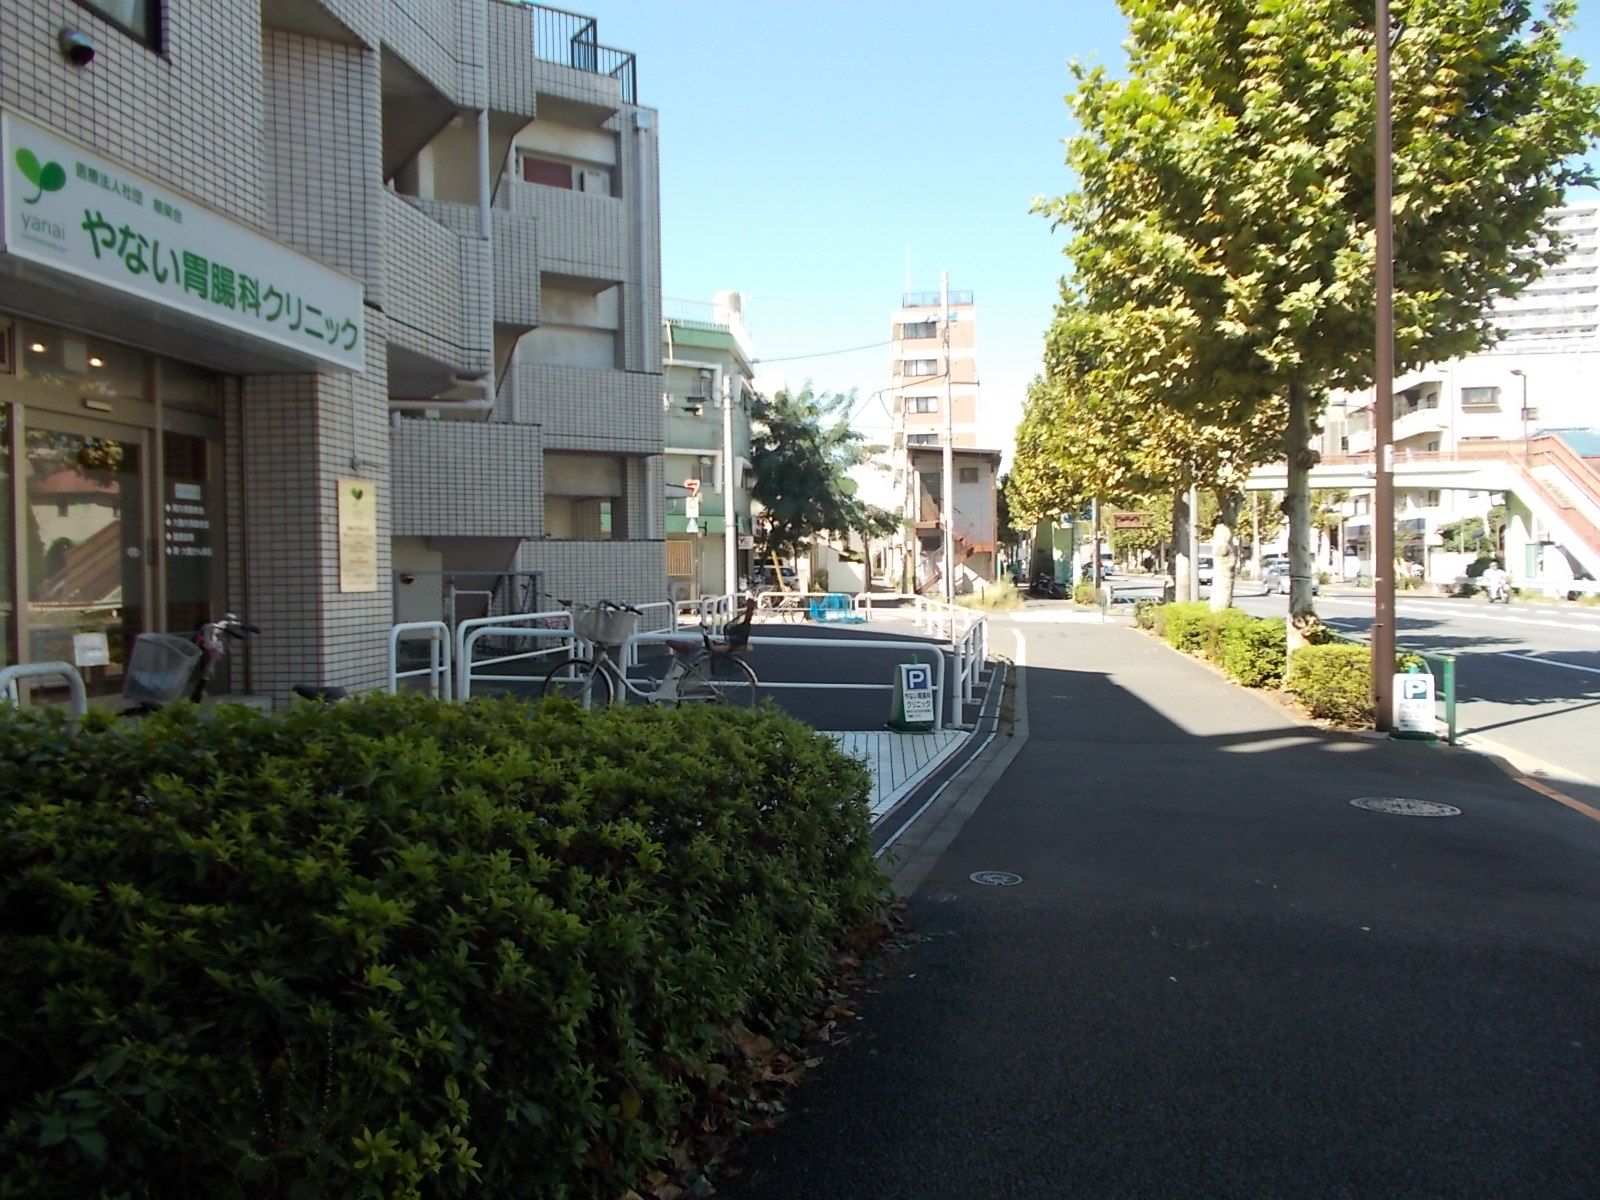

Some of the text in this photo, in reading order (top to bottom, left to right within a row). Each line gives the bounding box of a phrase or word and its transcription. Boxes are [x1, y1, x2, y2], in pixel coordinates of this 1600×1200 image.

[21, 212, 65, 240] yanai
[82, 208, 358, 351] やない胃腸科クリニック
[909, 670, 925, 688] P
[1405, 680, 1427, 699] P
